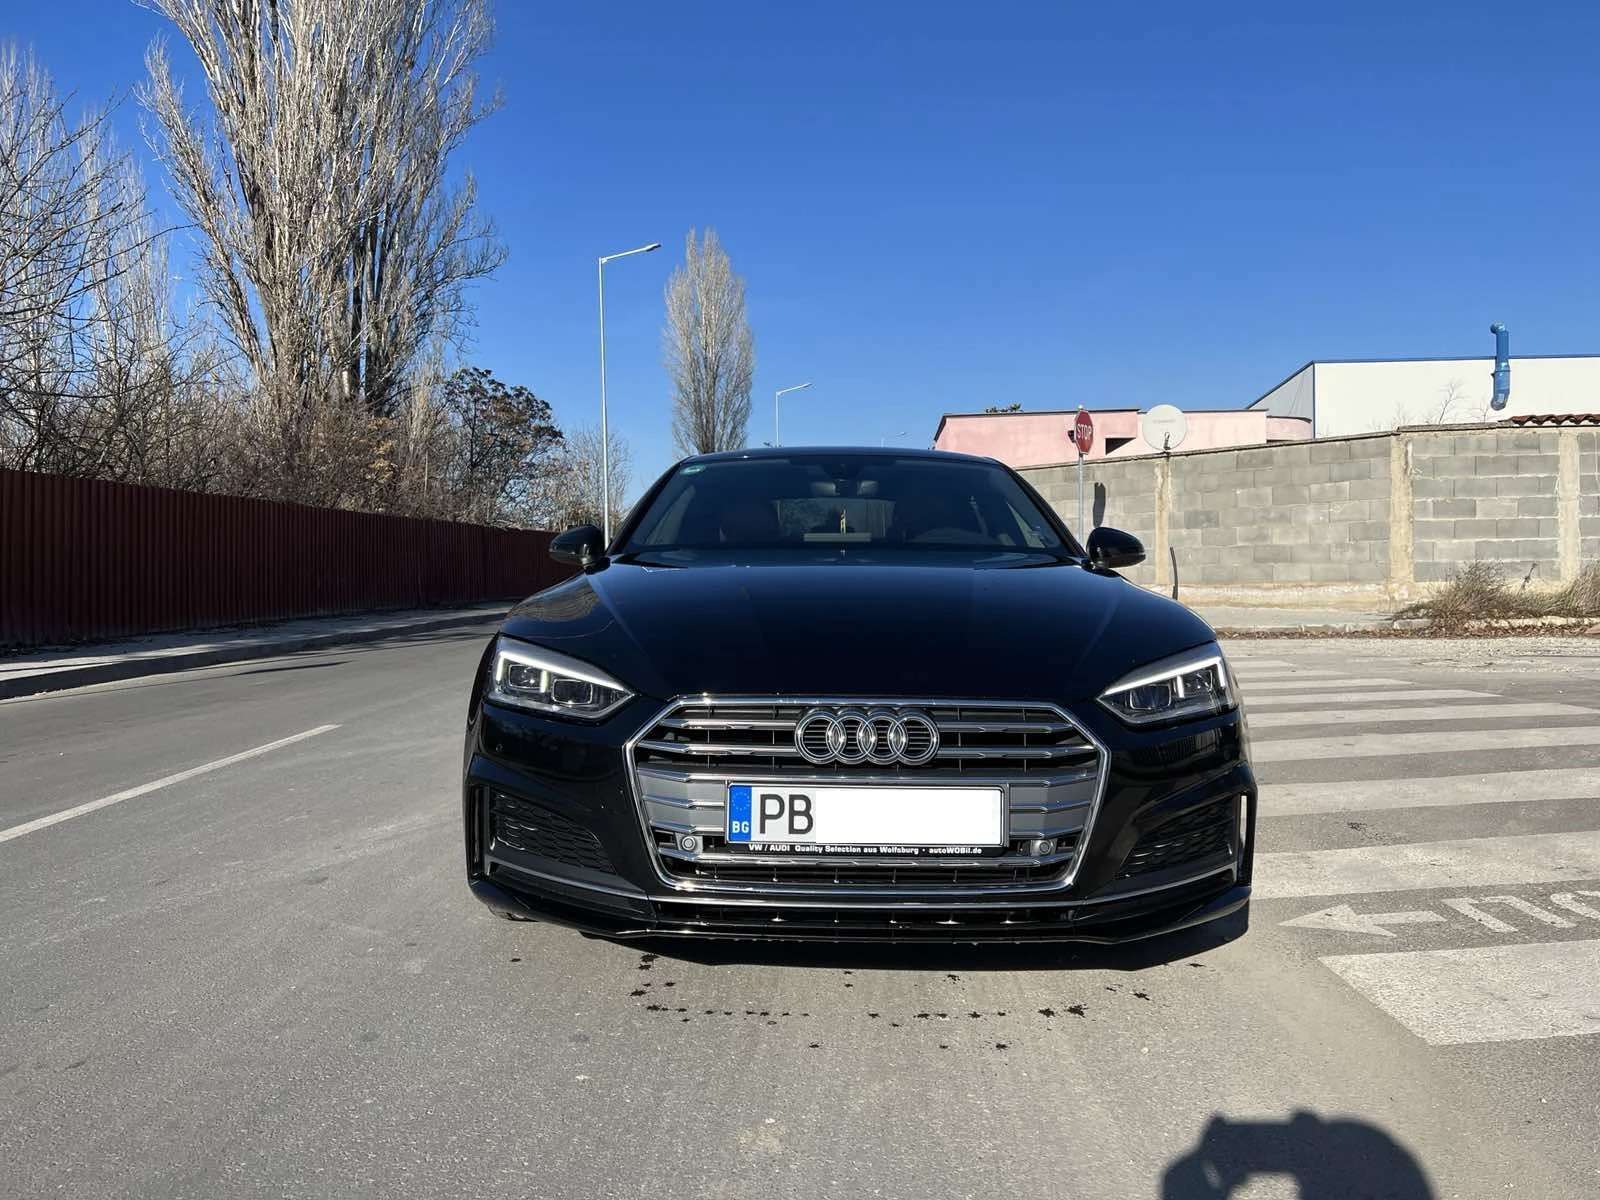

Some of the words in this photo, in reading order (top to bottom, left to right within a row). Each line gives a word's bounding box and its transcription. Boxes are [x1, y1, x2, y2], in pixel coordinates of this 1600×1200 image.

[1076, 423, 1092, 440] STOP
[760, 794, 813, 835] PB
[732, 820, 749, 833] BG
[748, 843, 762, 851] VW
[769, 844, 790, 852] AUDI
[794, 844, 823, 853] Quality
[824, 845, 861, 853] Selection
[880, 845, 919, 855] Wolfsburg
